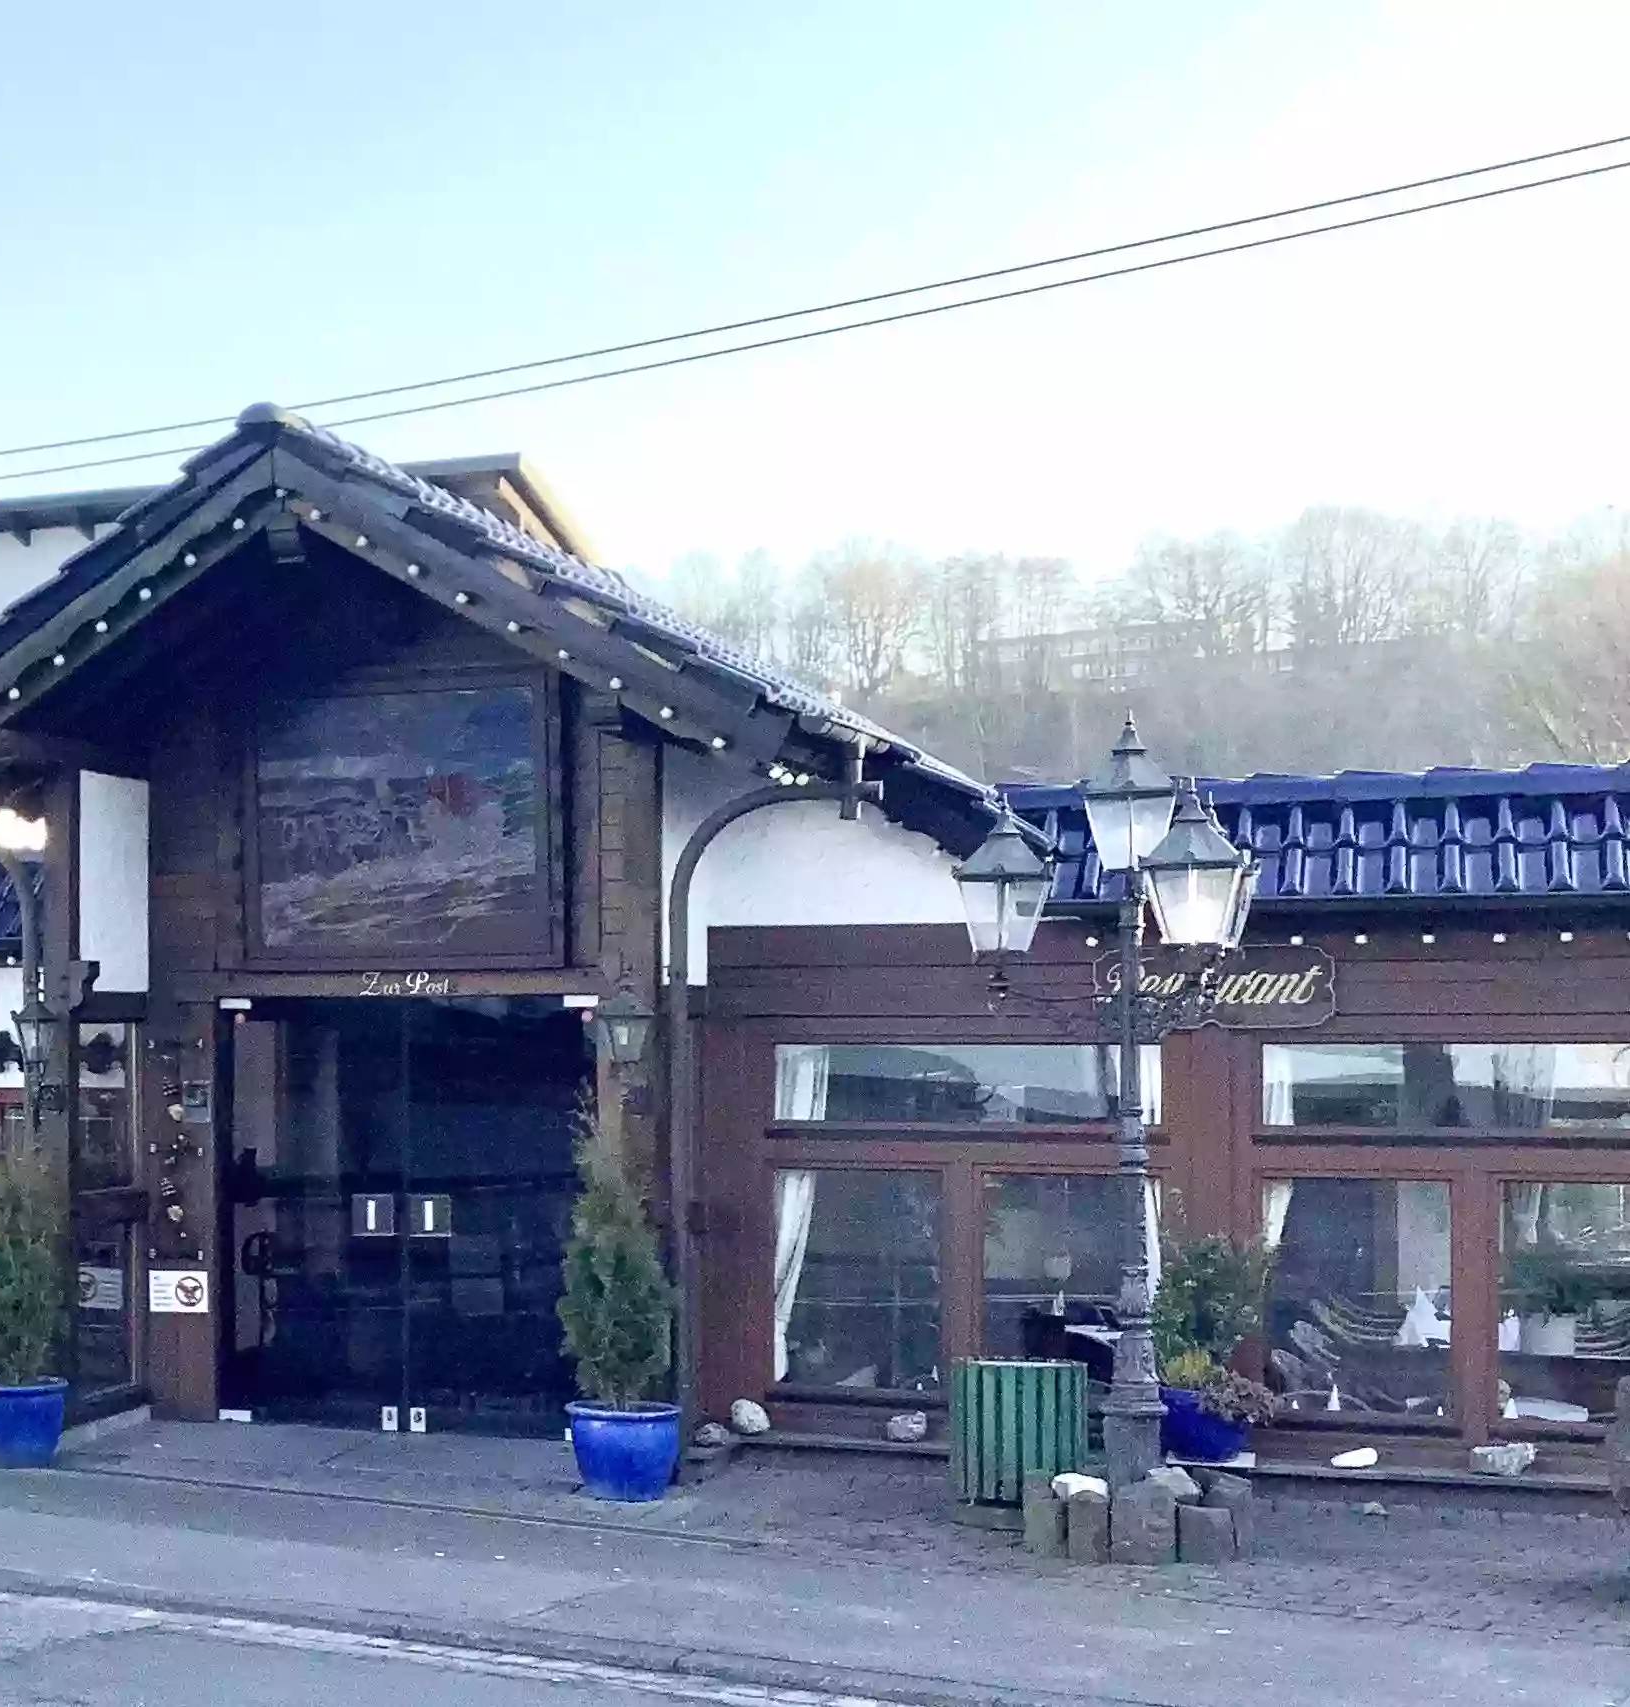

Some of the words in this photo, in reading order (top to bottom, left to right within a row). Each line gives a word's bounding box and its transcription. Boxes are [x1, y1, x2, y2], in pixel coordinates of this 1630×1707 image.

[358, 971, 401, 996] Zur
[405, 971, 449, 995] Post
[1106, 957, 1323, 1004] Resurant
